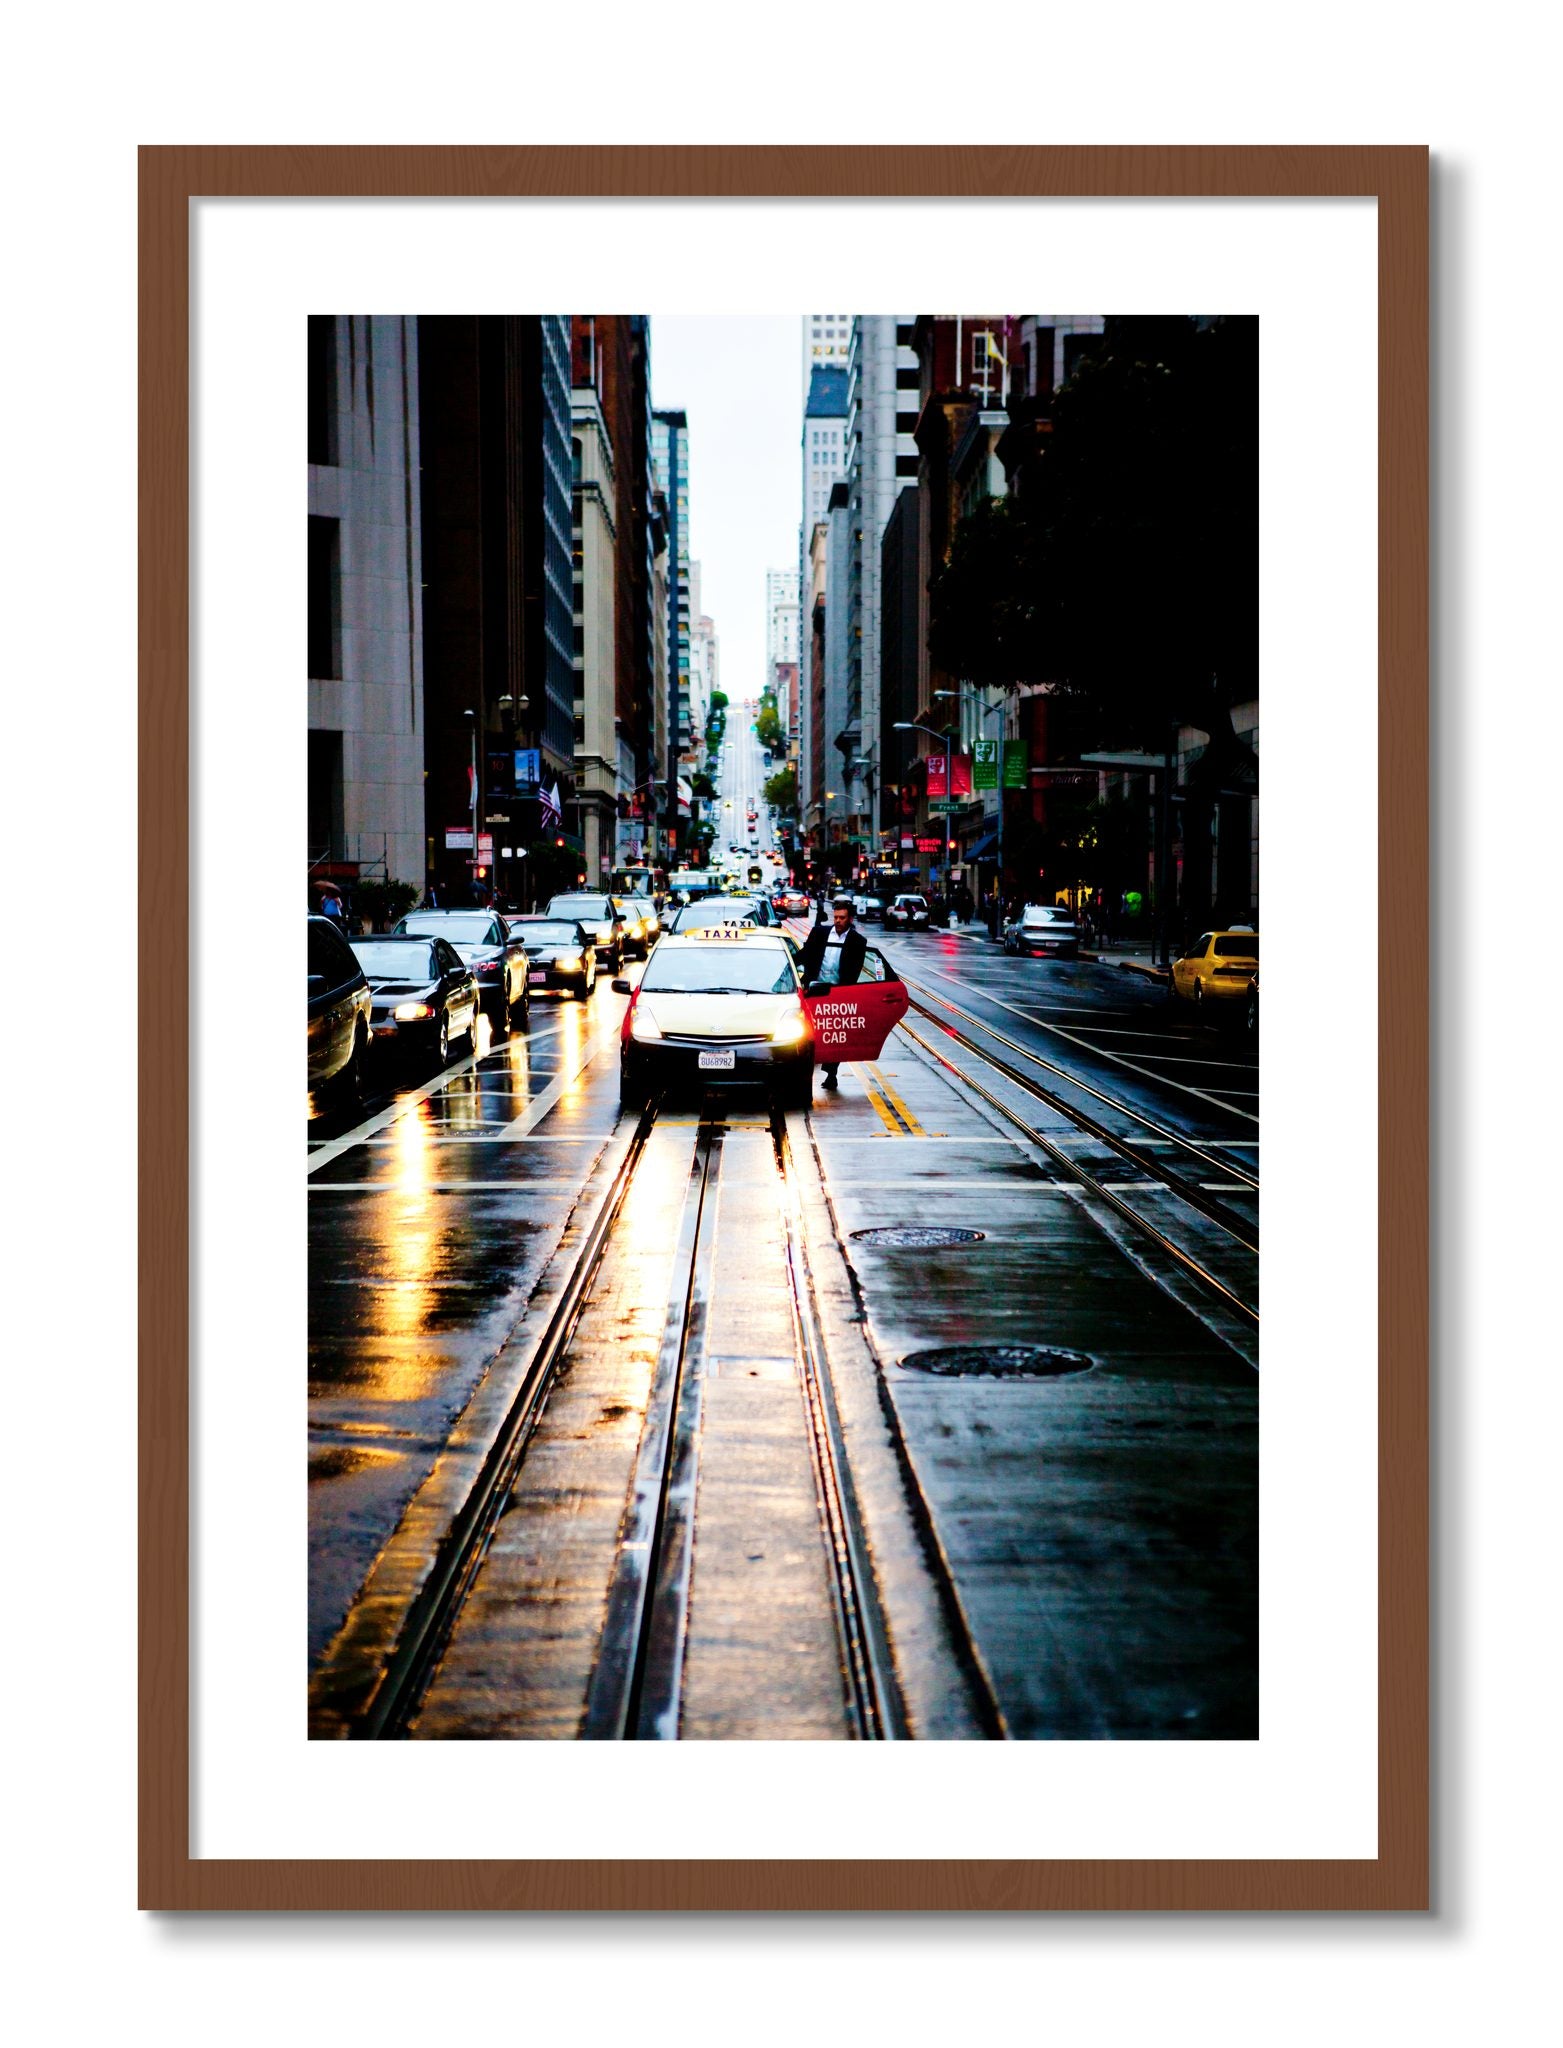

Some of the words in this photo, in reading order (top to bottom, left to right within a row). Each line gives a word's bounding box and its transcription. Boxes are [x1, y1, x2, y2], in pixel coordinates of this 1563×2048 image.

[723, 920, 751, 928] TAXI
[704, 930, 738, 939] TAXI
[815, 1003, 858, 1016] ARROW
[822, 1031, 847, 1044] CAB
